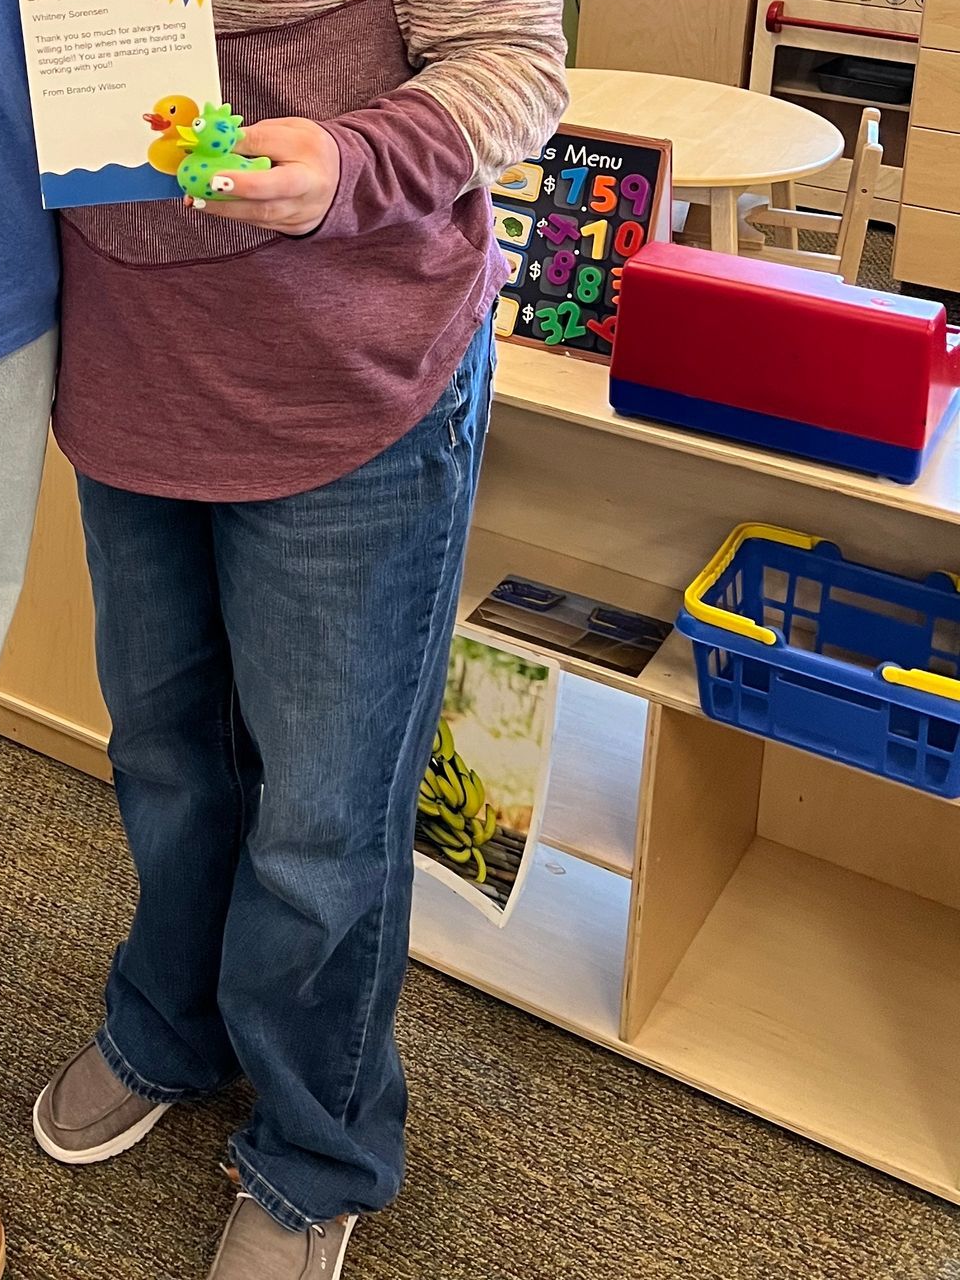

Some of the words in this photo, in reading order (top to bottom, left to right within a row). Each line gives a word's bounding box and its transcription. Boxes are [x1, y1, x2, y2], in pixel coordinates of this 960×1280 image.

[32, 13, 66, 22] Whitney
[68, 8, 109, 19] Sorensen
[35, 34, 61, 44] Thank
[63, 33, 79, 42] you
[81, 31, 92, 39] so
[93, 28, 117, 38] much
[132, 24, 161, 33] always
[163, 22, 187, 30] being
[37, 45, 62, 55] willing
[74, 42, 93, 51] help
[95, 39, 118, 48] when
[134, 36, 147, 44] are
[149, 33, 178, 43] having
[79, 53, 96, 61] You
[97, 51, 112, 59] are
[113, 47, 150, 58] amazing
[151, 45, 167, 54] and
[169, 44, 173, 52] I
[174, 43, 193, 51] love
[39, 66, 72, 76] working
[74, 63, 91, 72] with
[42, 88, 65, 97] From
[66, 85, 96, 95] Brandy
[98, 81, 127, 91] Wilson
[564, 144, 623, 170] Menu
